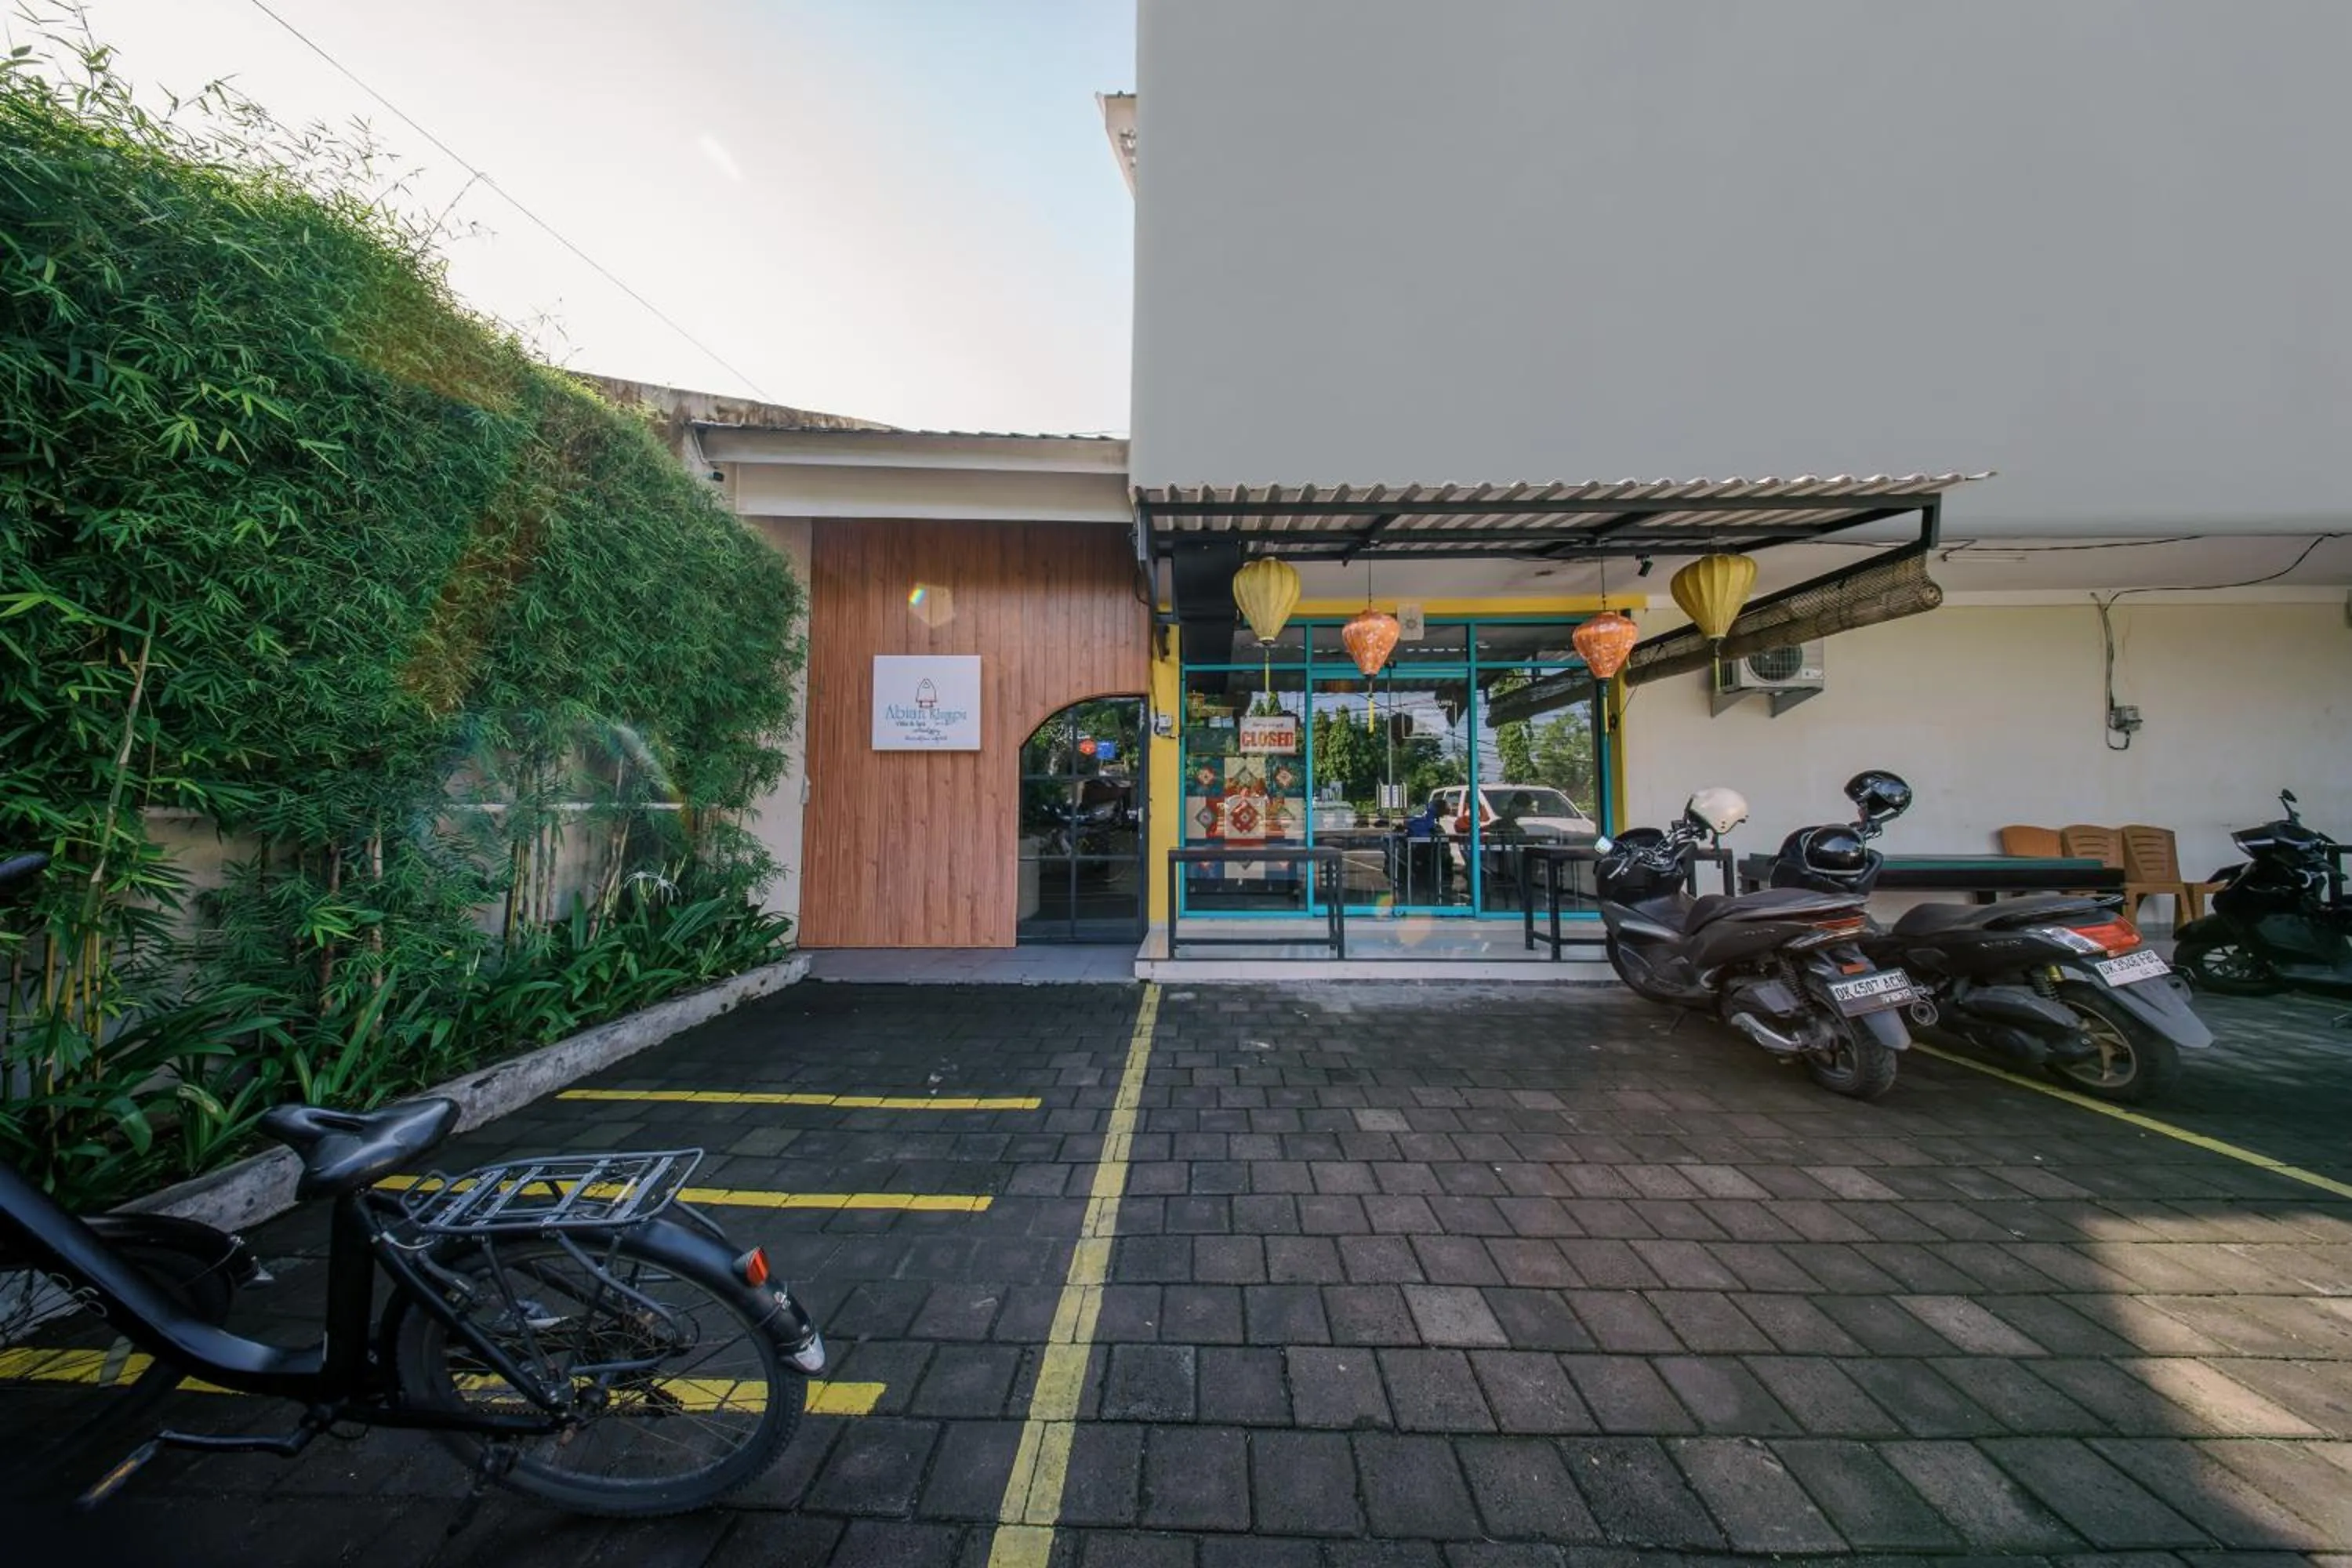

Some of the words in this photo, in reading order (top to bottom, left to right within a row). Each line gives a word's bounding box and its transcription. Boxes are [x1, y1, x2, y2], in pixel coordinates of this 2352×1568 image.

[885, 704, 925, 720] Abian
[1241, 731, 1294, 747] CLOSED
[2099, 960, 2118, 975] DK
[1835, 985, 1854, 1000] DK
[1854, 978, 1879, 995] 4507
